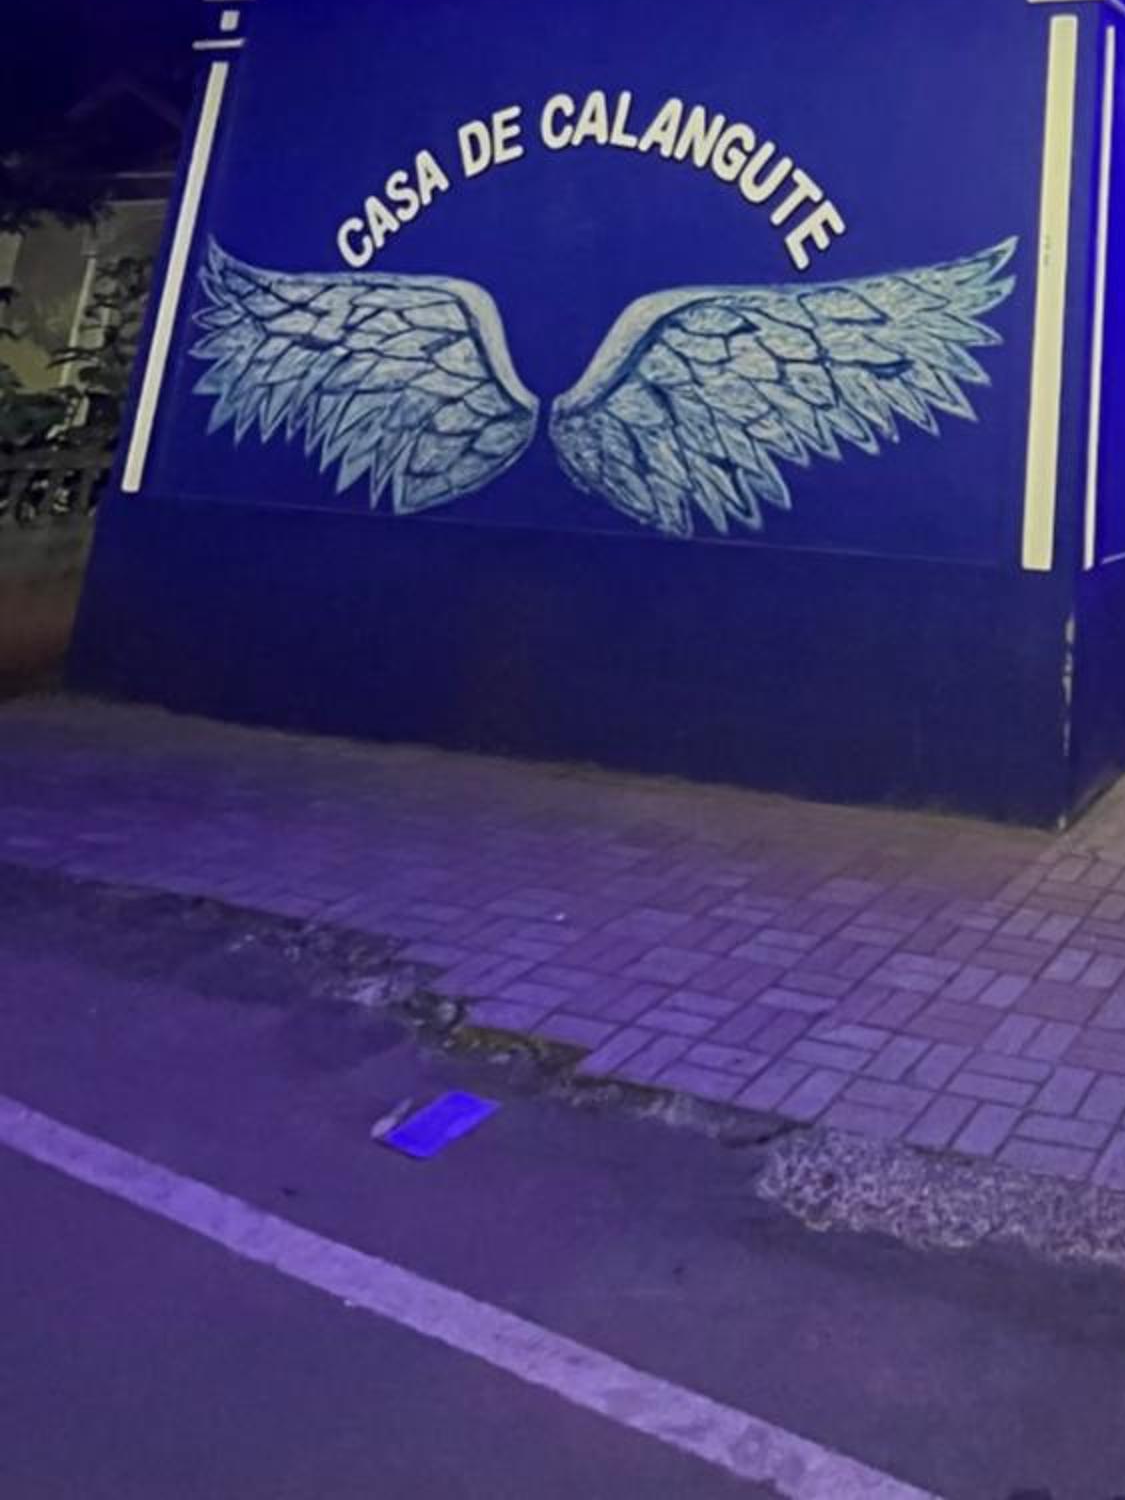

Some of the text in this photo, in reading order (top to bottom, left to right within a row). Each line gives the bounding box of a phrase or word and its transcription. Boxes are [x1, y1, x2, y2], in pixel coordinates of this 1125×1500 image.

[337, 90, 846, 270] CASA DE CALANGUTE
